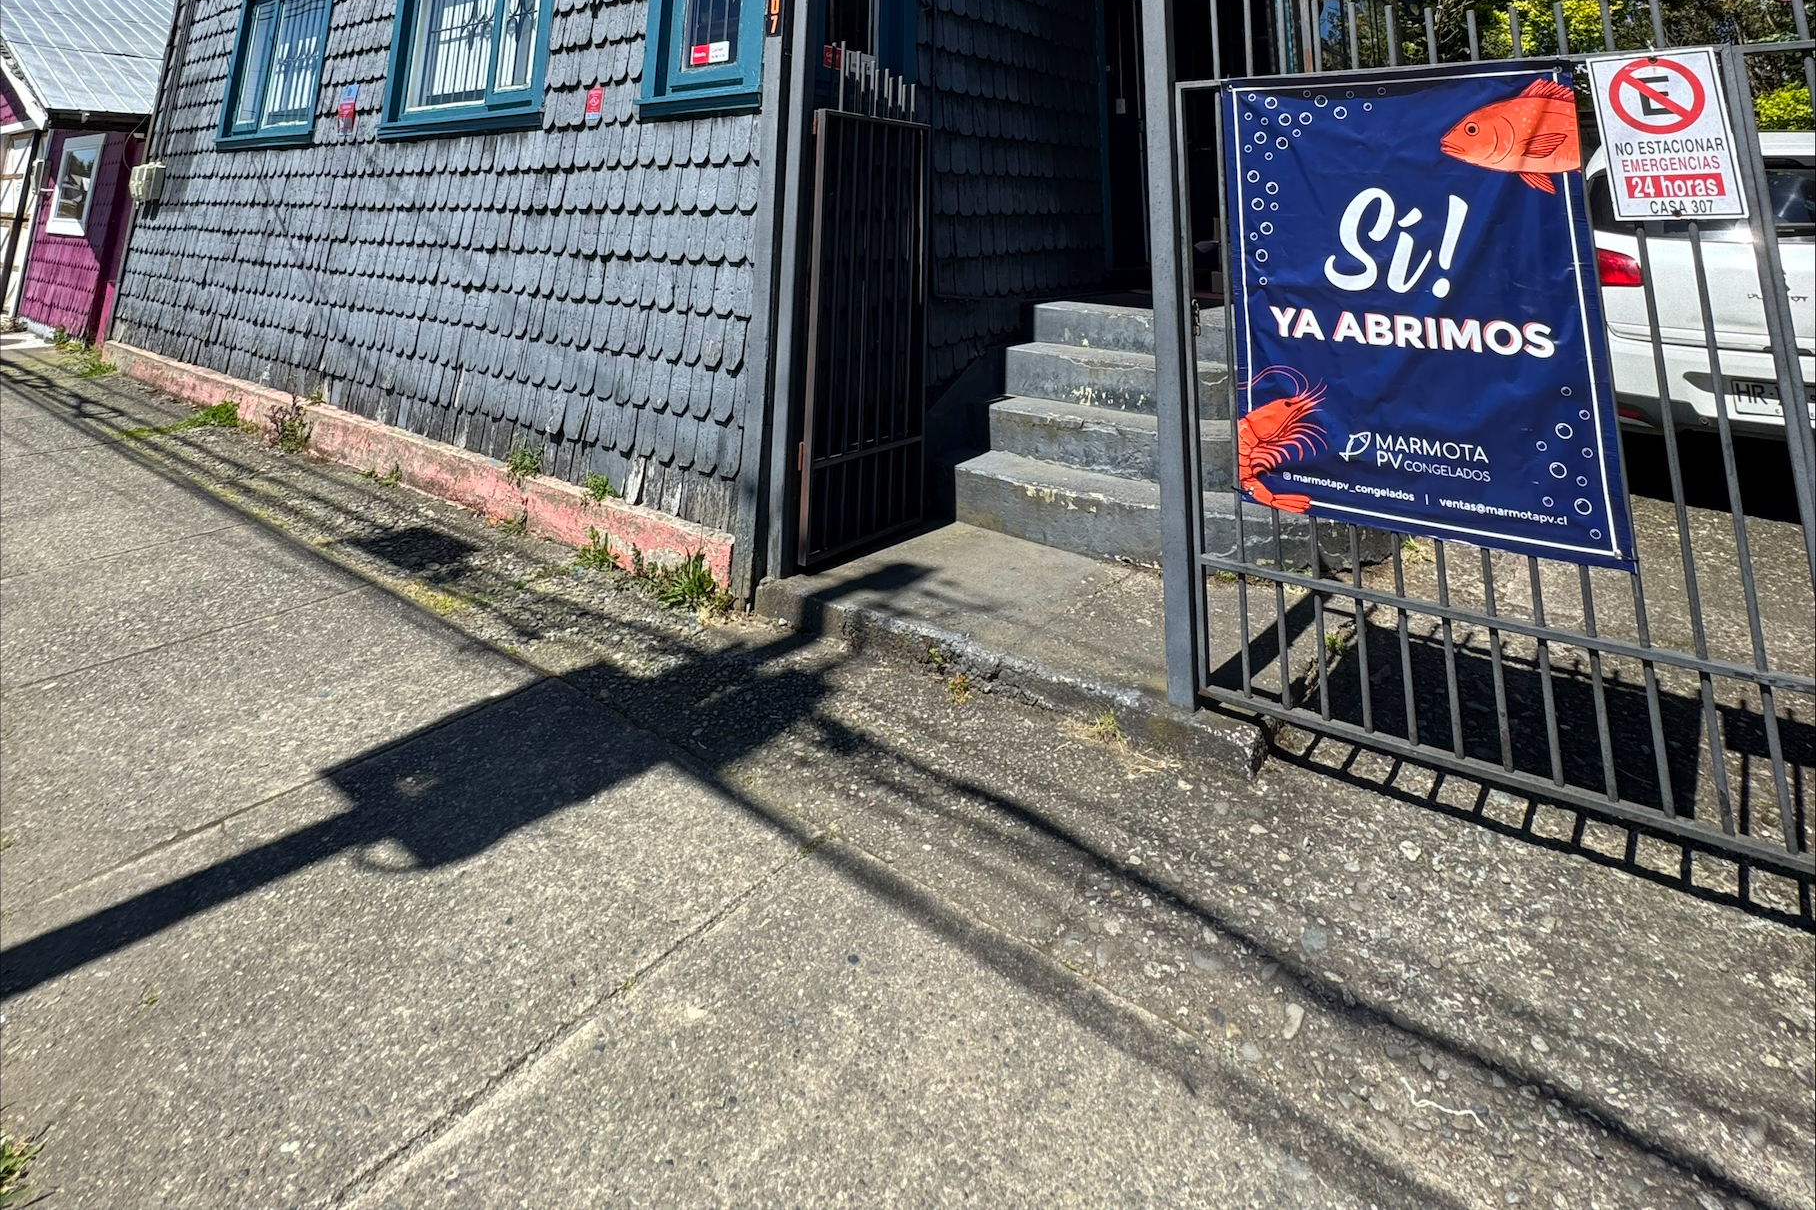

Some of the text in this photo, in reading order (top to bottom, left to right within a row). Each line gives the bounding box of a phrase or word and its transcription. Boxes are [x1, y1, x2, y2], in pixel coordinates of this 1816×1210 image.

[1615, 137, 1725, 156] NO ESTACIONAR
[1621, 155, 1720, 173] EMERGENCIAS
[1631, 175, 1719, 198] 24 horas
[1649, 199, 1714, 215] CASA 307
[1324, 187, 1468, 299] Sí!
[1269, 305, 1556, 360] YA ABRIMOS
[1375, 433, 1489, 465] MARMOTA
[1376, 451, 1492, 483] PV CONGELADOS
[1292, 472, 1569, 527] marmotapv_congelados ventas@marmotapv.cl
